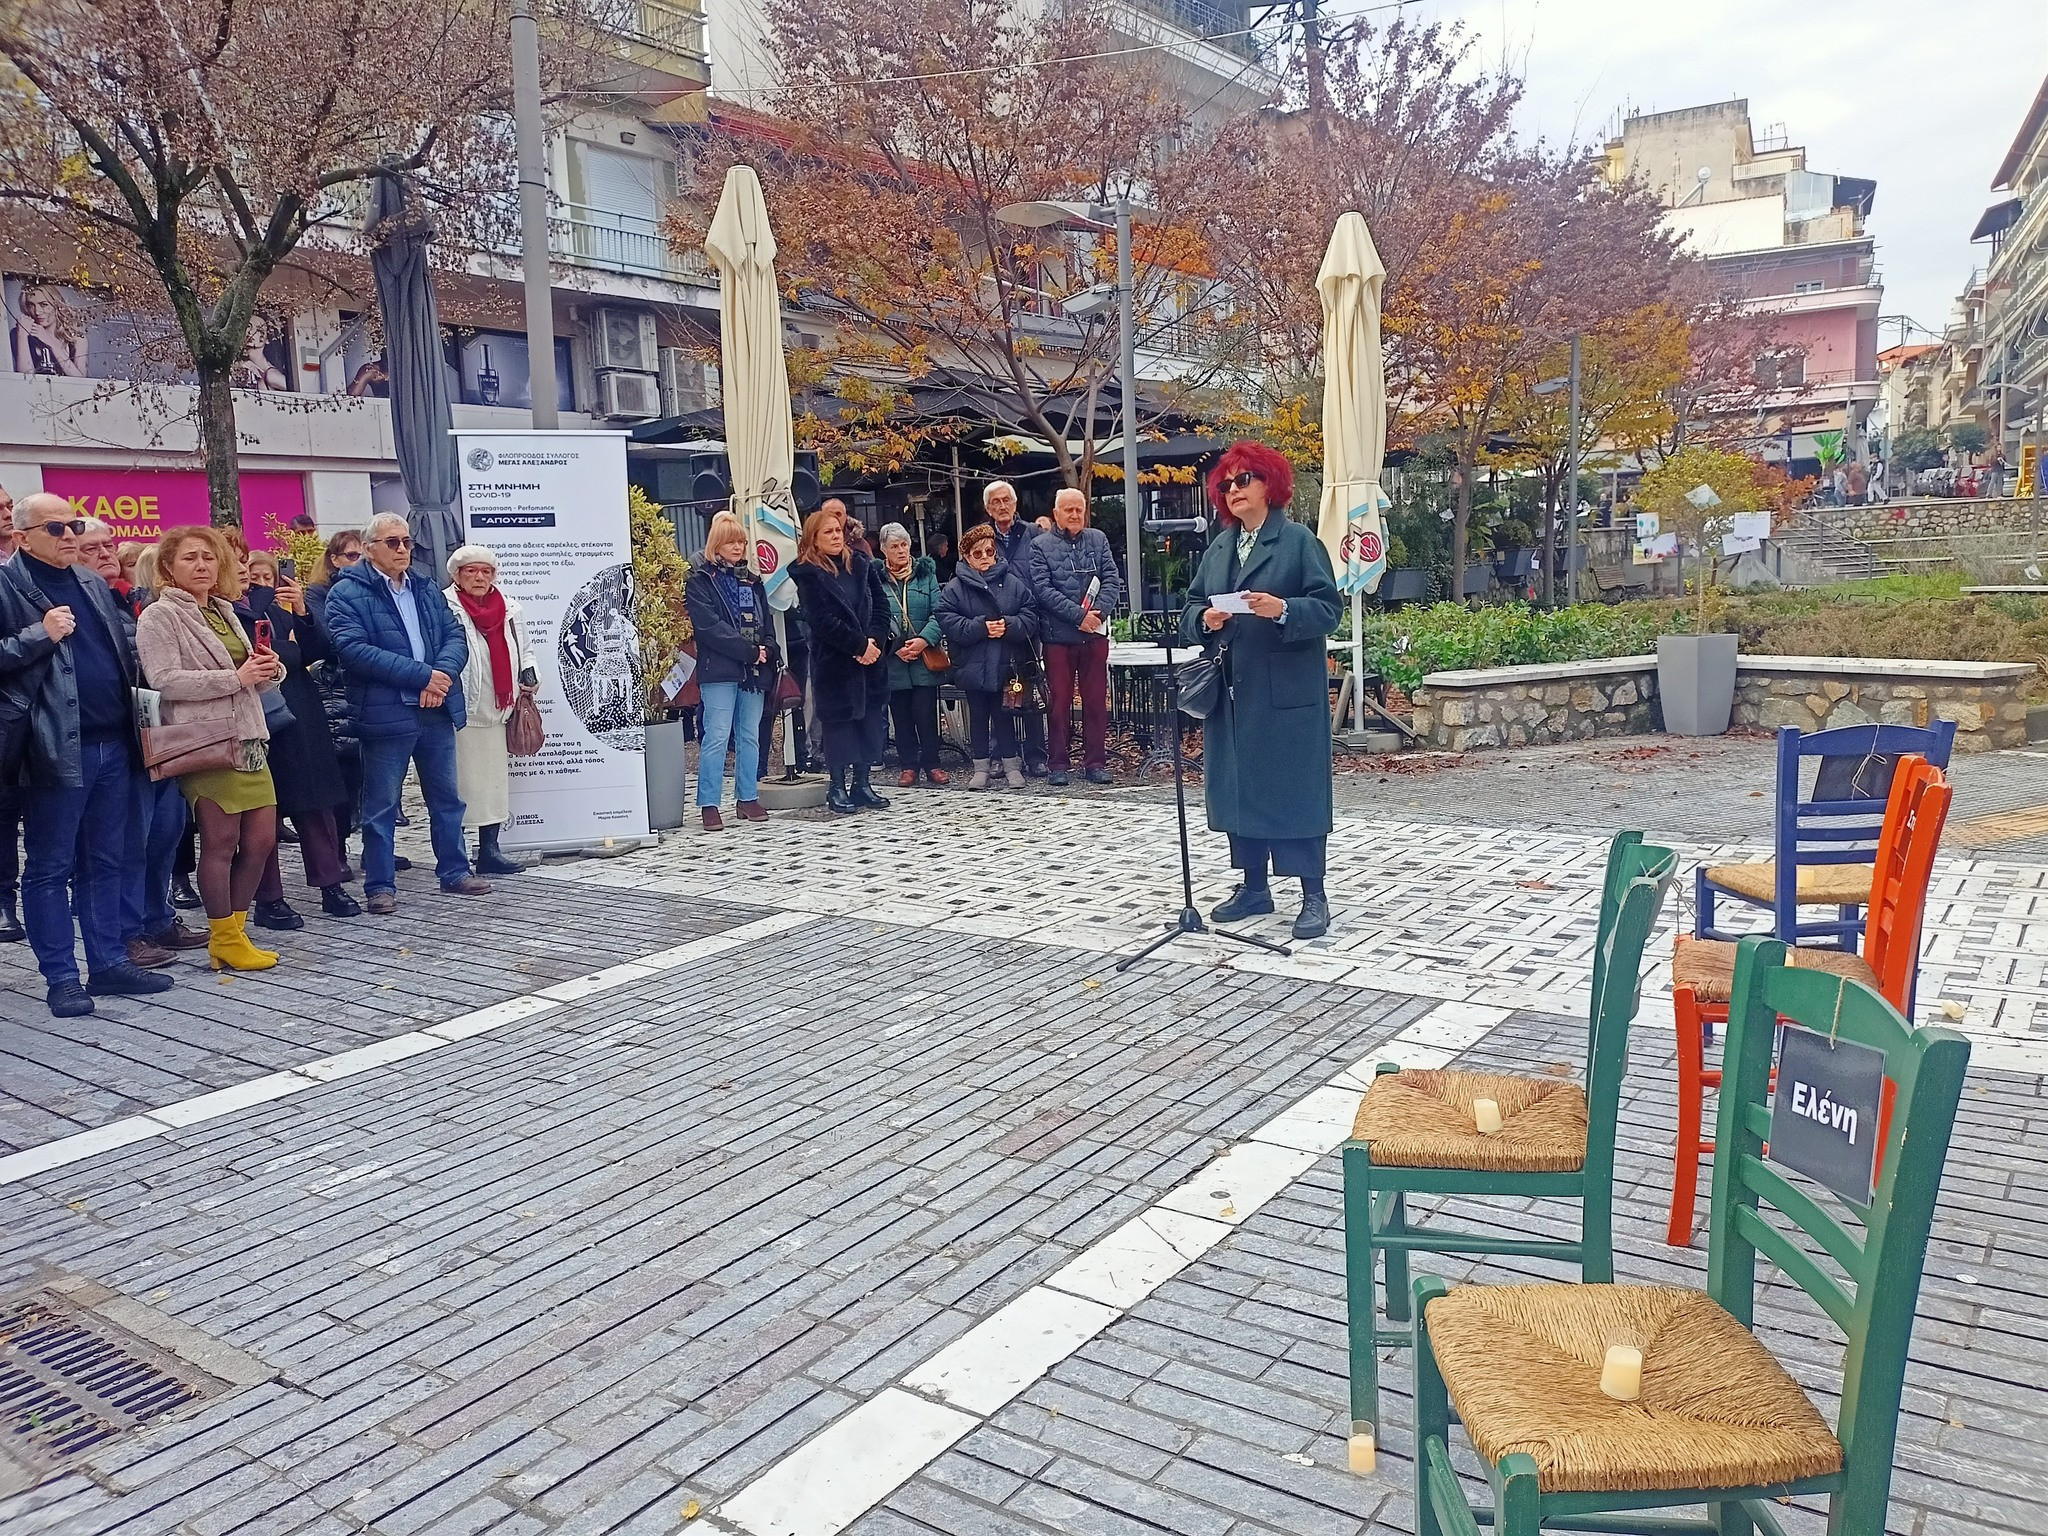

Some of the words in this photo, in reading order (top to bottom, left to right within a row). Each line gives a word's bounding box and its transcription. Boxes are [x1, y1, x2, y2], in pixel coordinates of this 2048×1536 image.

[68, 495, 160, 520] ΚΑΘΕ
[109, 525, 162, 537] ΟΜΑΔΑ
[522, 541, 545, 549] άδειες
[1791, 1080, 1858, 1145] Ελένη
